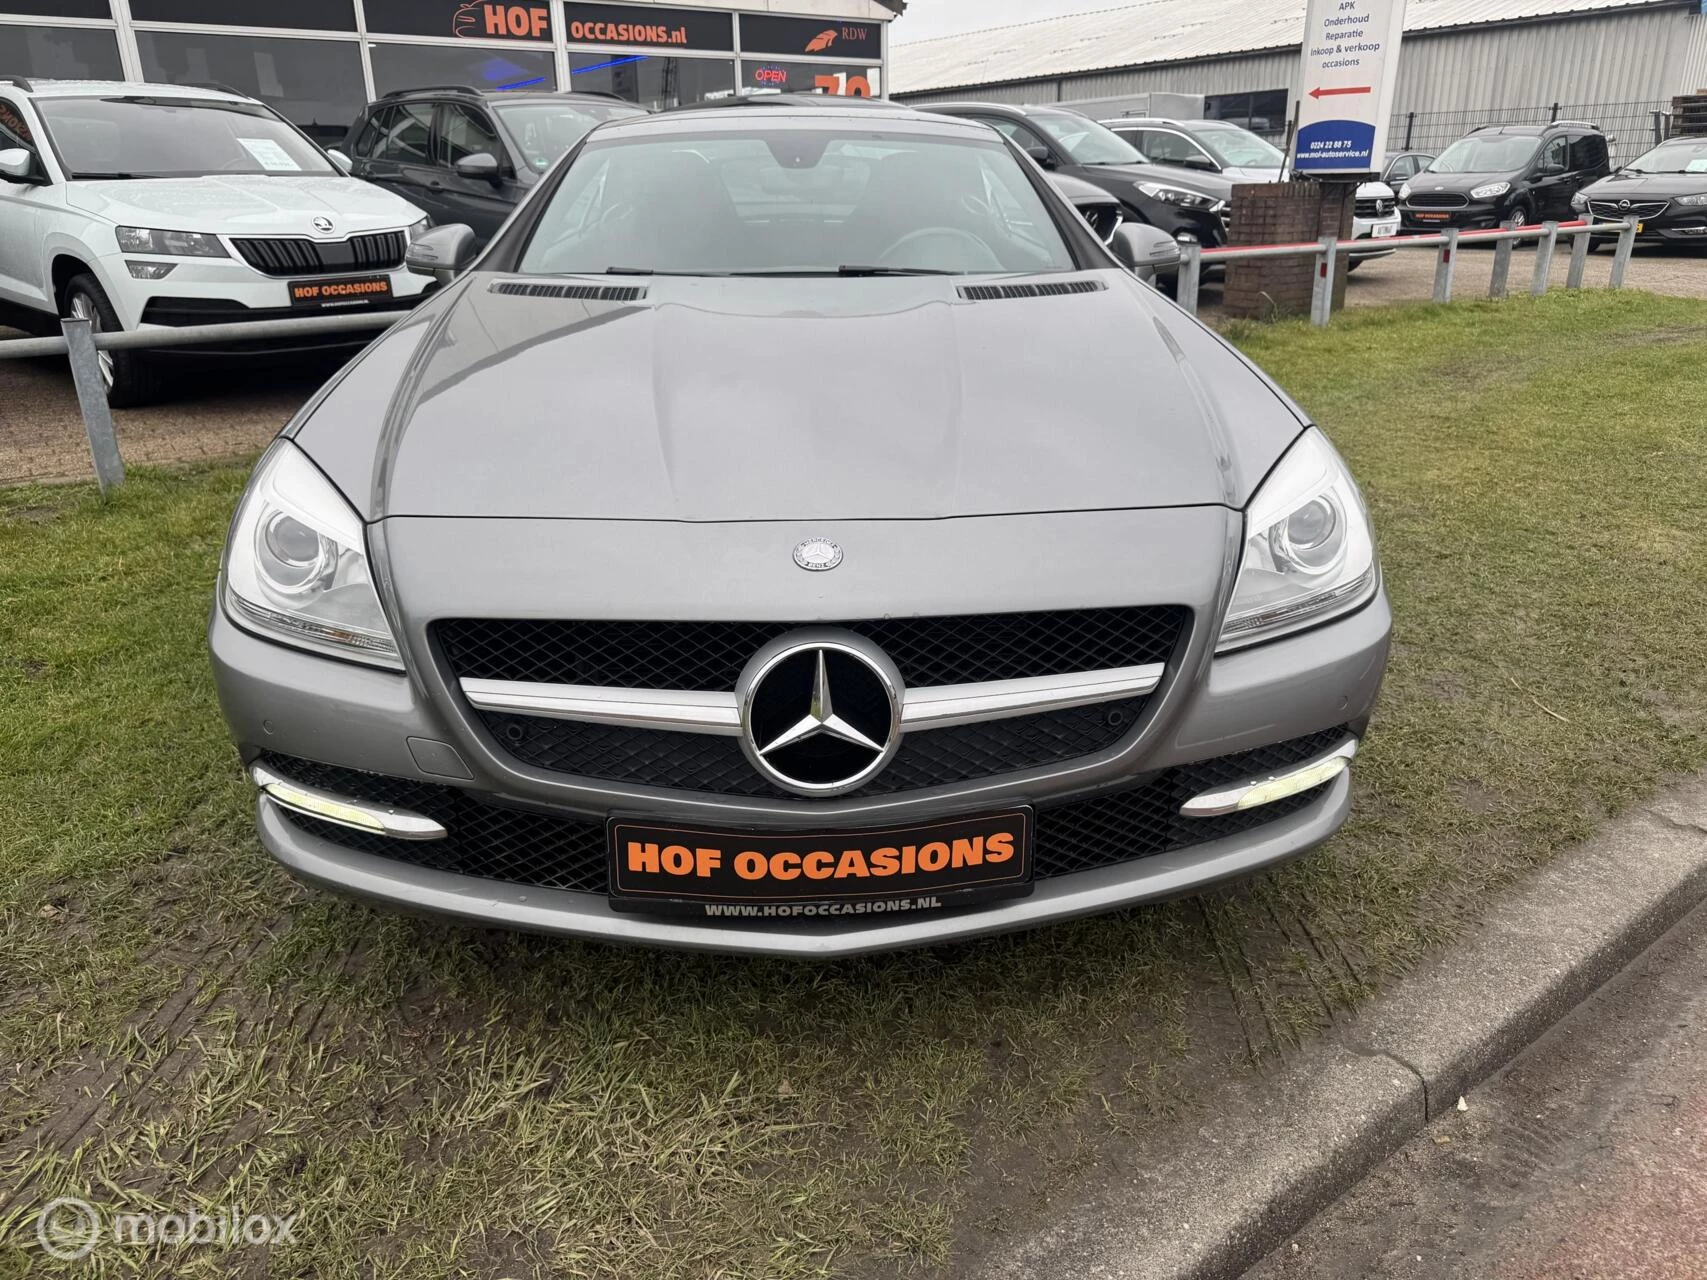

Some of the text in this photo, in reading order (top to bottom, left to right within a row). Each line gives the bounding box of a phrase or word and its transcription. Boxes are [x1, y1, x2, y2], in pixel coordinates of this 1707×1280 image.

[1338, 1, 1355, 11] APK
[483, 4, 548, 37] HOF
[1323, 13, 1370, 27] Onderhoud
[570, 21, 687, 44] OCCASIONS.nl
[842, 27, 867, 40] RDW
[1325, 28, 1364, 41] Reparatie
[1310, 42, 1380, 56] Inkoop & verkoop
[1322, 58, 1360, 68] occasions
[755, 68, 787, 83] OPEN
[1296, 150, 1369, 159] www.mol-autoservice.nl
[294, 281, 388, 298] HOF OCCASIONS
[627, 832, 1015, 881] HOF OCCASIONS
[705, 897, 942, 917] WWW.HOFOCCASIONS.NL
